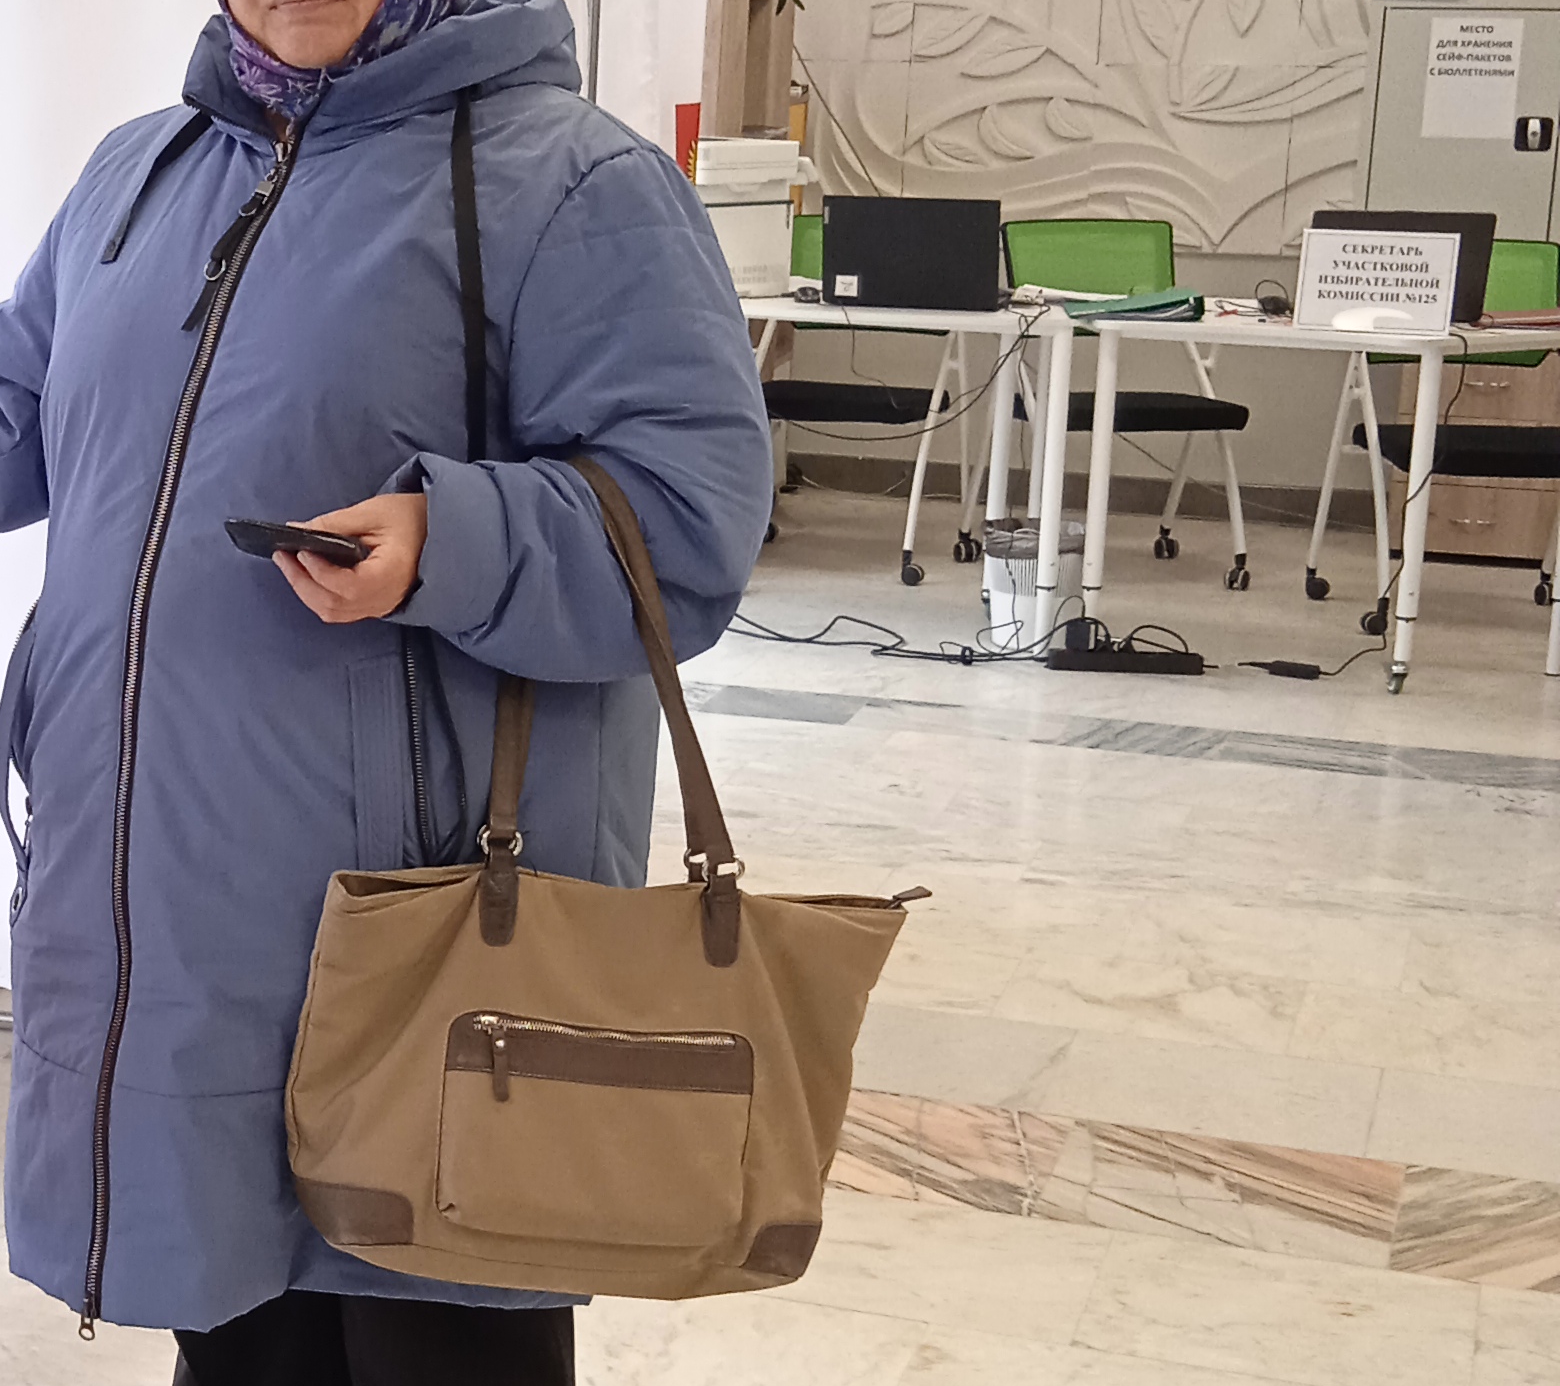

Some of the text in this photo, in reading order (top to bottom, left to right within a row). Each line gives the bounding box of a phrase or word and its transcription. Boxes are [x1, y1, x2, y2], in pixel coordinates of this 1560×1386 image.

[1459, 24, 1494, 34] МЕСТО
[1436, 39, 1513, 49] ДЛЯ ХРАНЕНИЯ
[1436, 52, 1512, 62] СЕЙФ-ПАКЕТОВ
[1429, 67, 1515, 77] С БЮЛЛЕТЕНЯМИ
[1341, 243, 1423, 256] СЕКРЕТАРЬ
[1332, 259, 1430, 274] УЧАСТКОВОЙ
[1318, 274, 1440, 290] ИЗБИРАТЕЛЬНОЙ
[1317, 289, 1400, 303] КОМИССИИ
